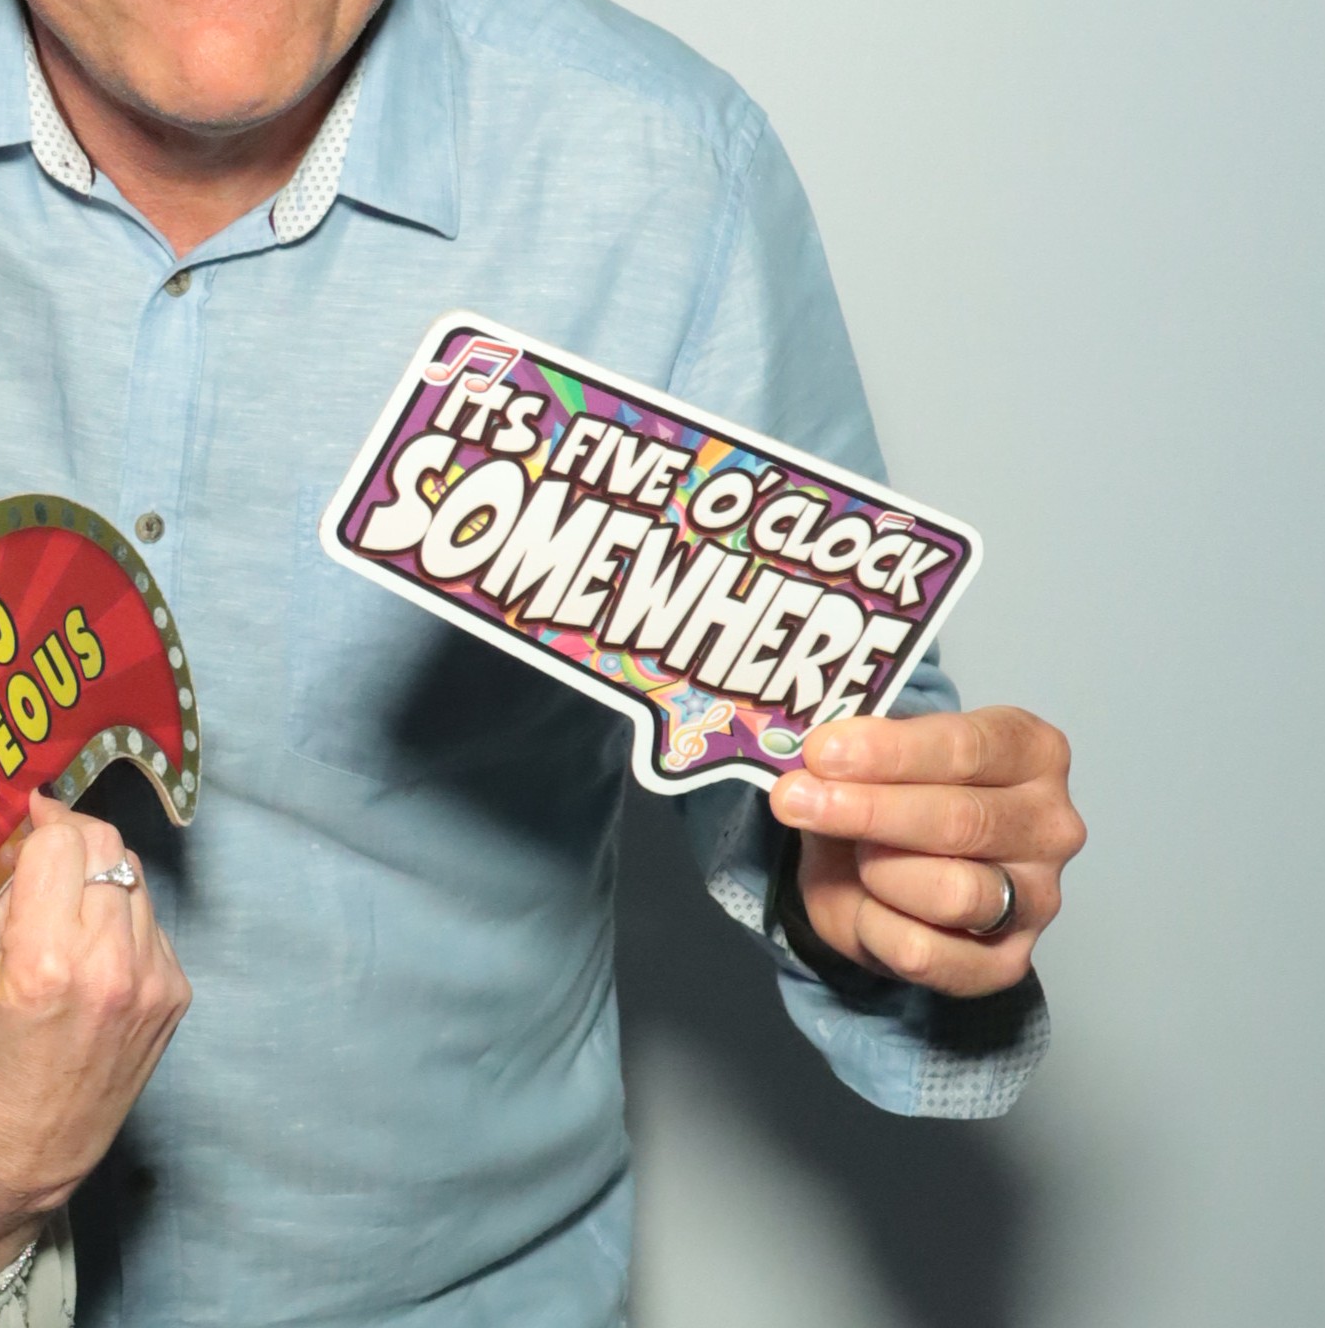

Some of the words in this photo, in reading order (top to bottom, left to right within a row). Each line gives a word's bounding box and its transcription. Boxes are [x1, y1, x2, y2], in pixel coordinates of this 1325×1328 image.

[359, 433, 913, 727] SOMEWHERE
[551, 417, 688, 508] FIVE
[691, 468, 950, 607] O'CLOCK
